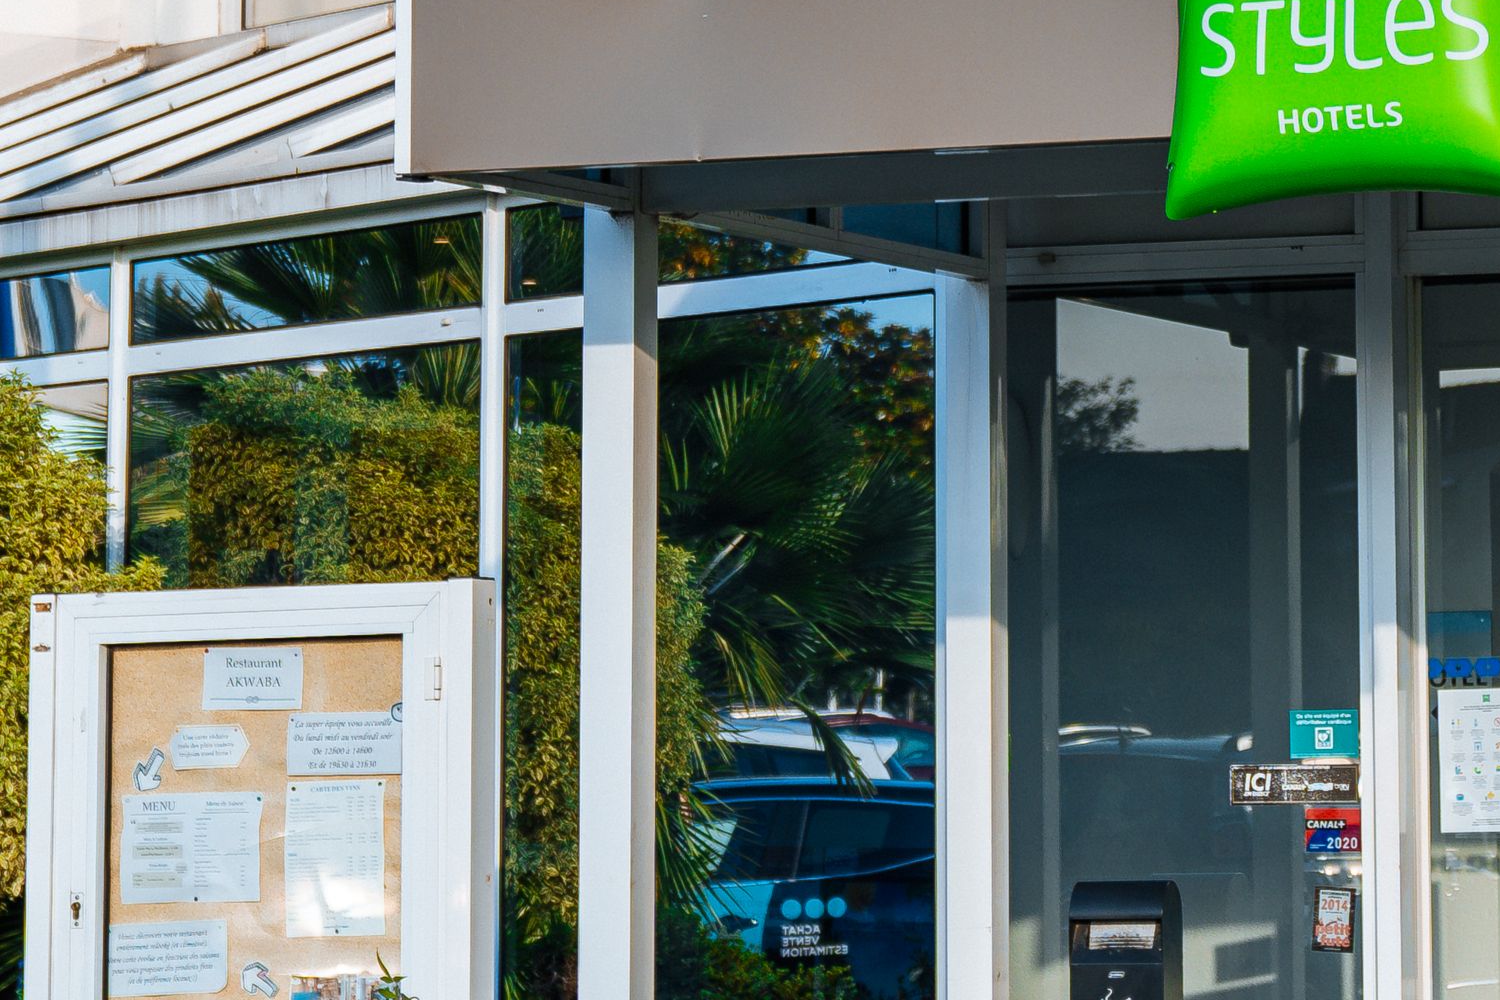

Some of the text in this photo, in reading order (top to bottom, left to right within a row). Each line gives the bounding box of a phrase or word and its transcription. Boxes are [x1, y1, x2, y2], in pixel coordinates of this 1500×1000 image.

[1277, 101, 1403, 135] HOTELS
[225, 657, 282, 669] Restaurant
[225, 676, 281, 688] AKWABA
[1245, 772, 1272, 792] ICI
[142, 801, 176, 812] MENU
[1307, 820, 1346, 830] CANAL+
[1327, 837, 1358, 849] 2020
[1321, 899, 1349, 911] 2014
